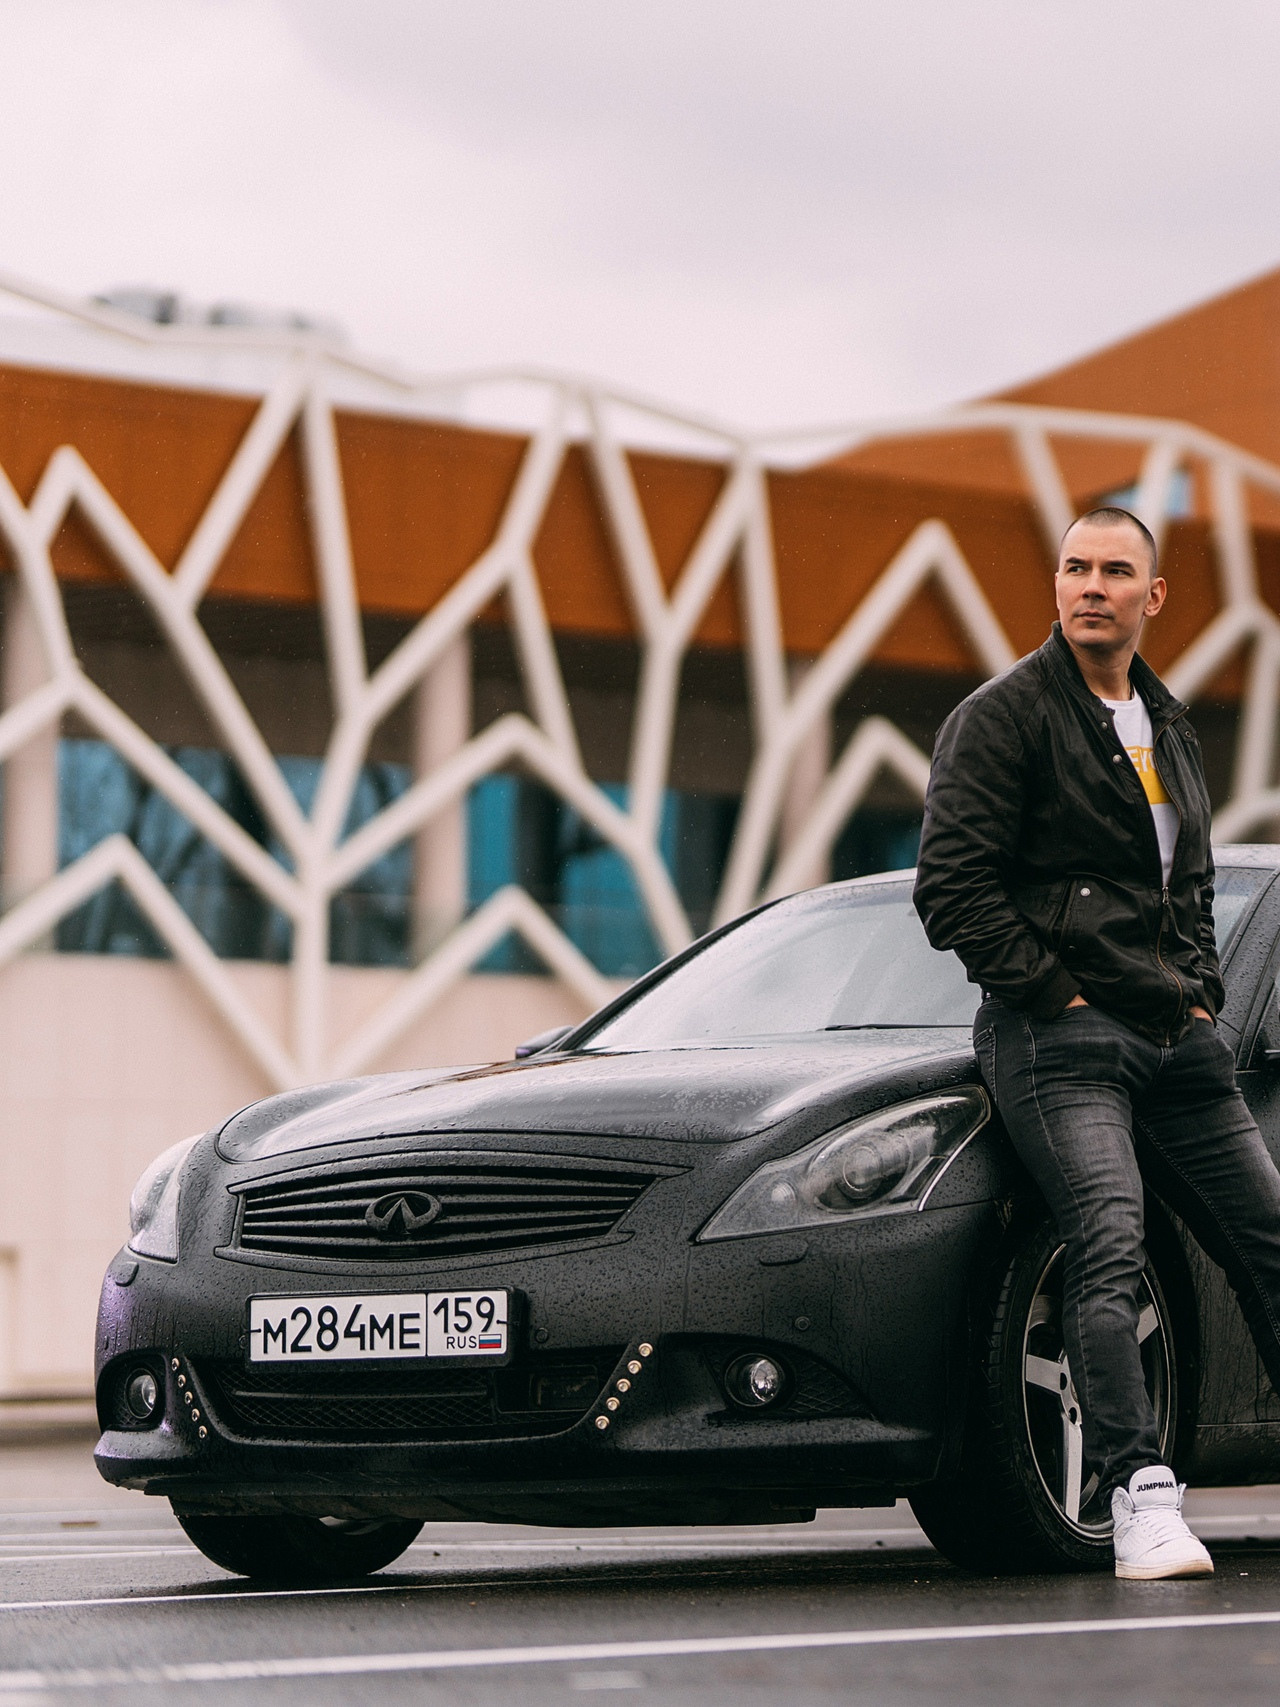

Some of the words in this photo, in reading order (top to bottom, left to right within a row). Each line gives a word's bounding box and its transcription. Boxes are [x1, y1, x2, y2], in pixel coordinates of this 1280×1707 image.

[433, 1296, 495, 1333] 159
[446, 1335, 478, 1349] RUS
[1136, 1481, 1175, 1492] JUMPMAN
